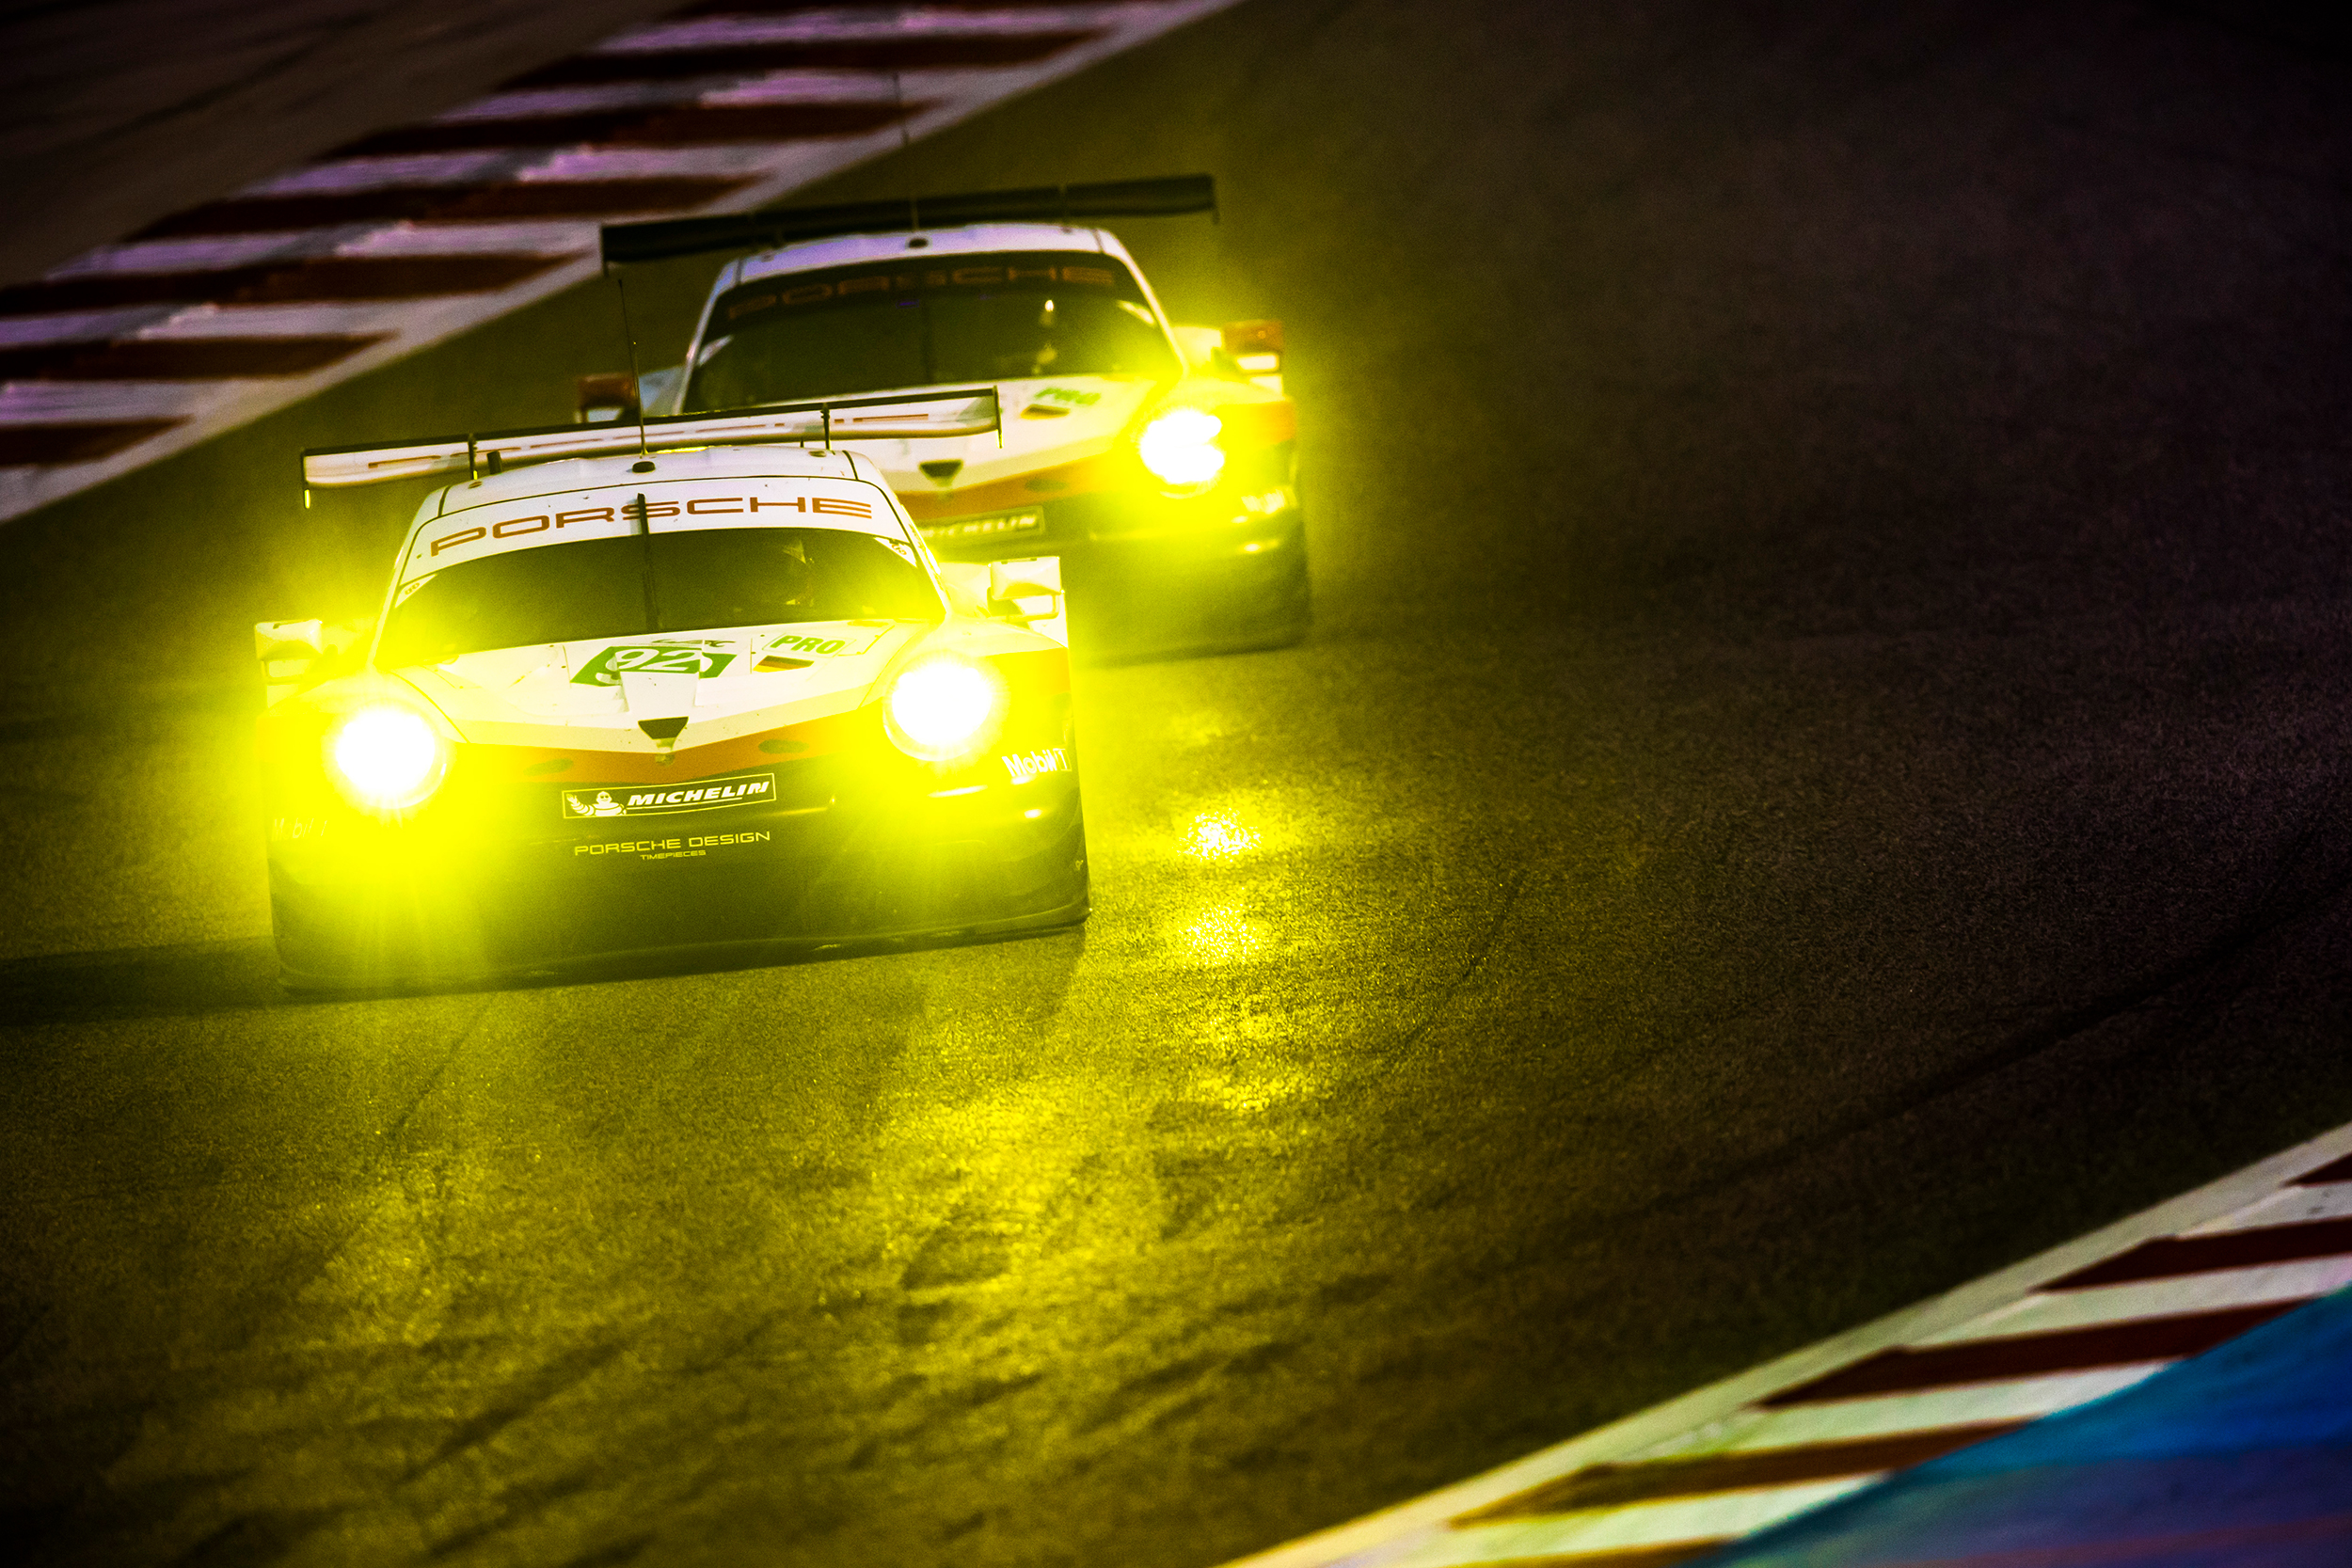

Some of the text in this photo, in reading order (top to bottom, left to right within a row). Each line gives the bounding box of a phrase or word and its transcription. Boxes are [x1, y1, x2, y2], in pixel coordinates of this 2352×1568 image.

[430, 496, 873, 557] PORSCHE
[770, 634, 846, 655] PRO
[596, 648, 713, 685] 92
[1002, 749, 1057, 778] Mobil
[628, 781, 770, 806] MICHELIN
[574, 831, 771, 856] PORSCHE DESIGN
[639, 849, 707, 861] TIMEPIECES
